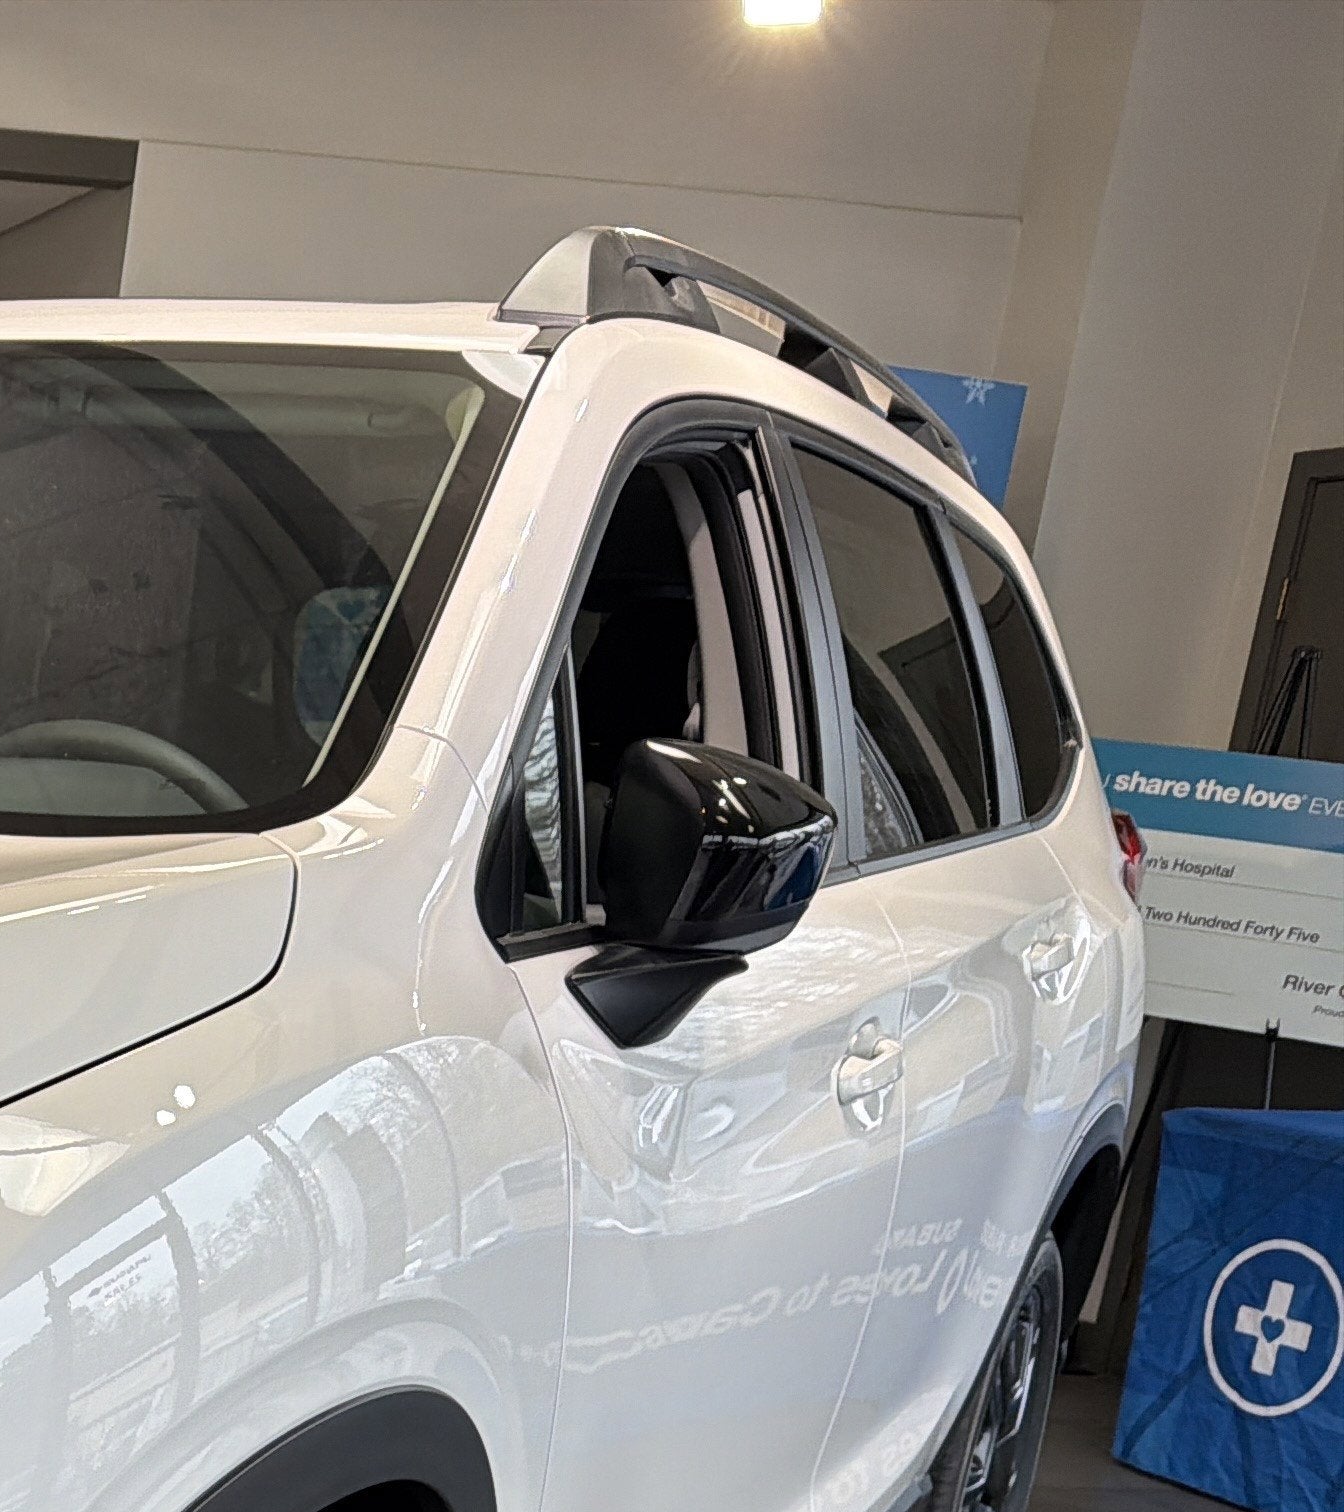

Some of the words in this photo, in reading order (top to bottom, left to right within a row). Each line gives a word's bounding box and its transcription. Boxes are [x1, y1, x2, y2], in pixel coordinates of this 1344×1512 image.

[1113, 769, 1191, 798] share
[1195, 779, 1242, 805] the
[1172, 857, 1236, 878] Hospital
[1145, 905, 1174, 923] Two
[1176, 911, 1243, 933] Hundred
[1243, 920, 1285, 942] Forty
[1286, 926, 1321, 944] Five
[1282, 974, 1336, 996] River
